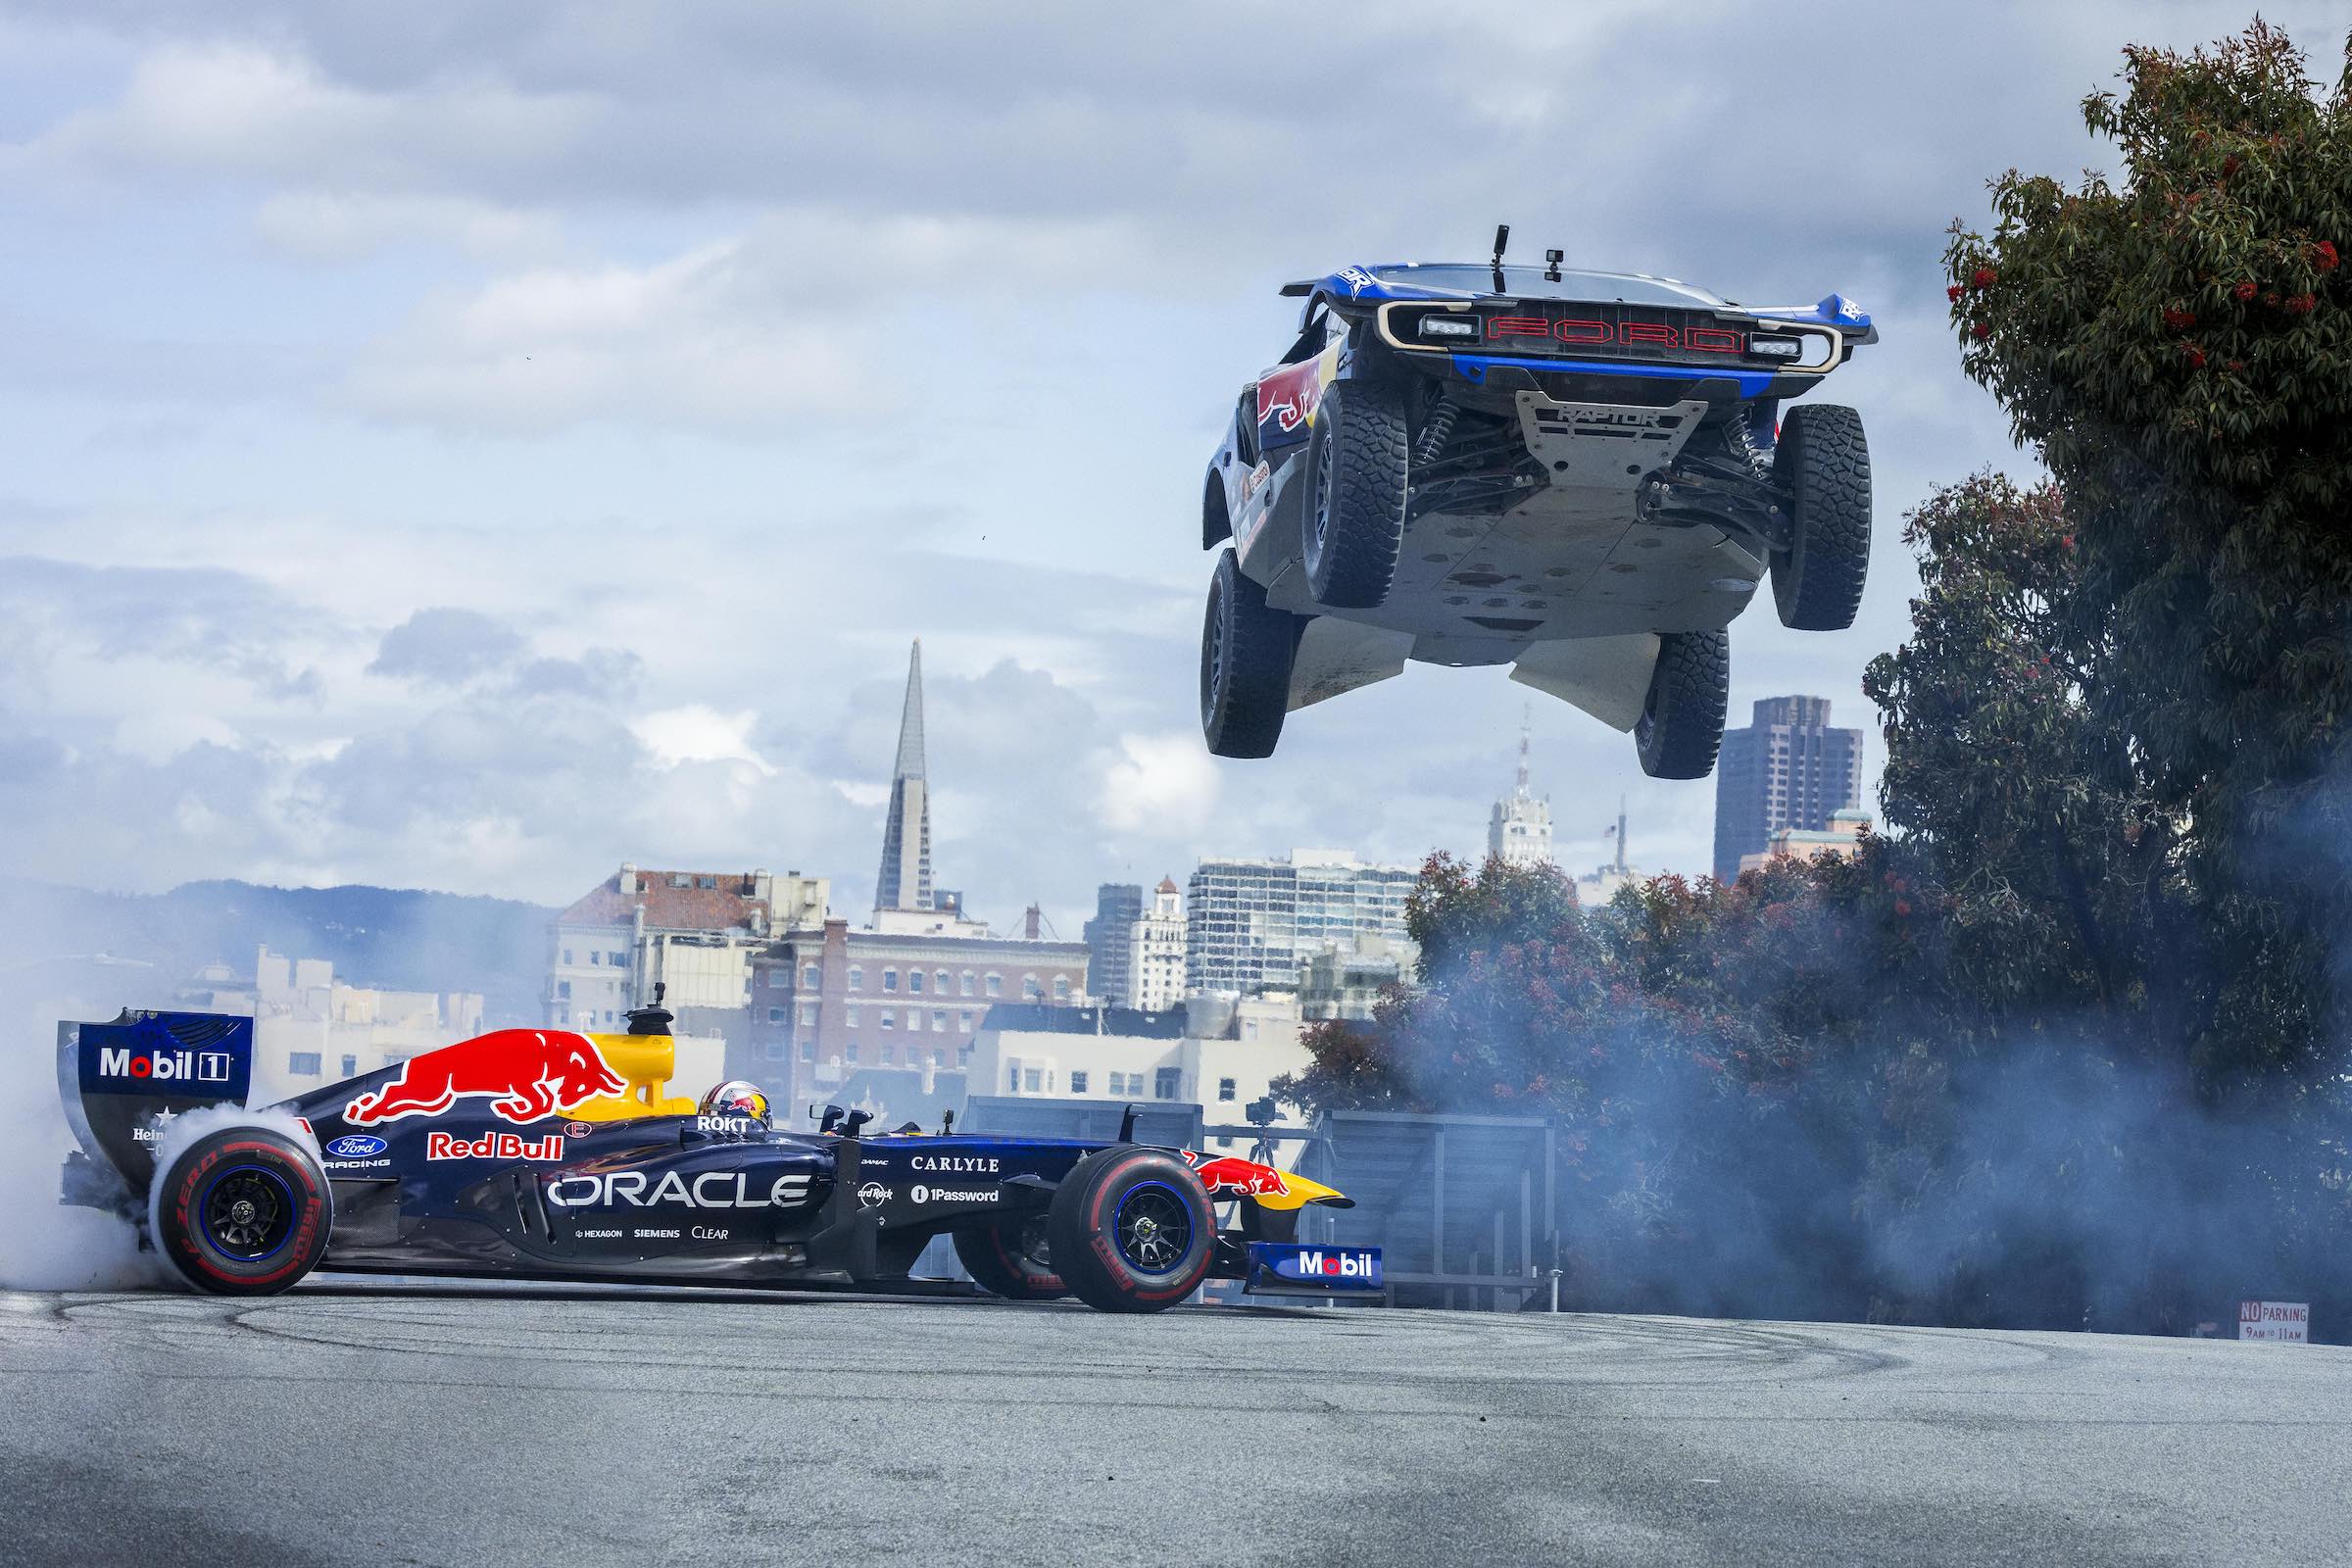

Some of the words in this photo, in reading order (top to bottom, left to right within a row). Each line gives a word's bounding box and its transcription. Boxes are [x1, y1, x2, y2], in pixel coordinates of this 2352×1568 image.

[1488, 317, 1745, 354] FORD
[1557, 408, 1660, 427] RAPTOR
[100, 1048, 192, 1080] Mobil
[697, 1115, 751, 1133] ROKT
[338, 1138, 376, 1153] Ford
[428, 1133, 495, 1160] Red
[498, 1134, 564, 1161] Bull
[323, 1159, 391, 1169] RACING
[910, 1156, 1000, 1173] CARLYLE
[547, 1171, 812, 1207] ORACLE
[872, 1188, 893, 1200] Rock
[931, 1189, 999, 1202] 1Password
[634, 1229, 680, 1238] SIEMENS
[691, 1226, 729, 1240] CLEAR
[1299, 1251, 1372, 1276] Mobil
[2240, 1301, 2260, 1321] NO
[2263, 1307, 2306, 1322] PARKING
[2246, 1326, 2265, 1339] 9AM
[2278, 1328, 2301, 1341] 11AM
